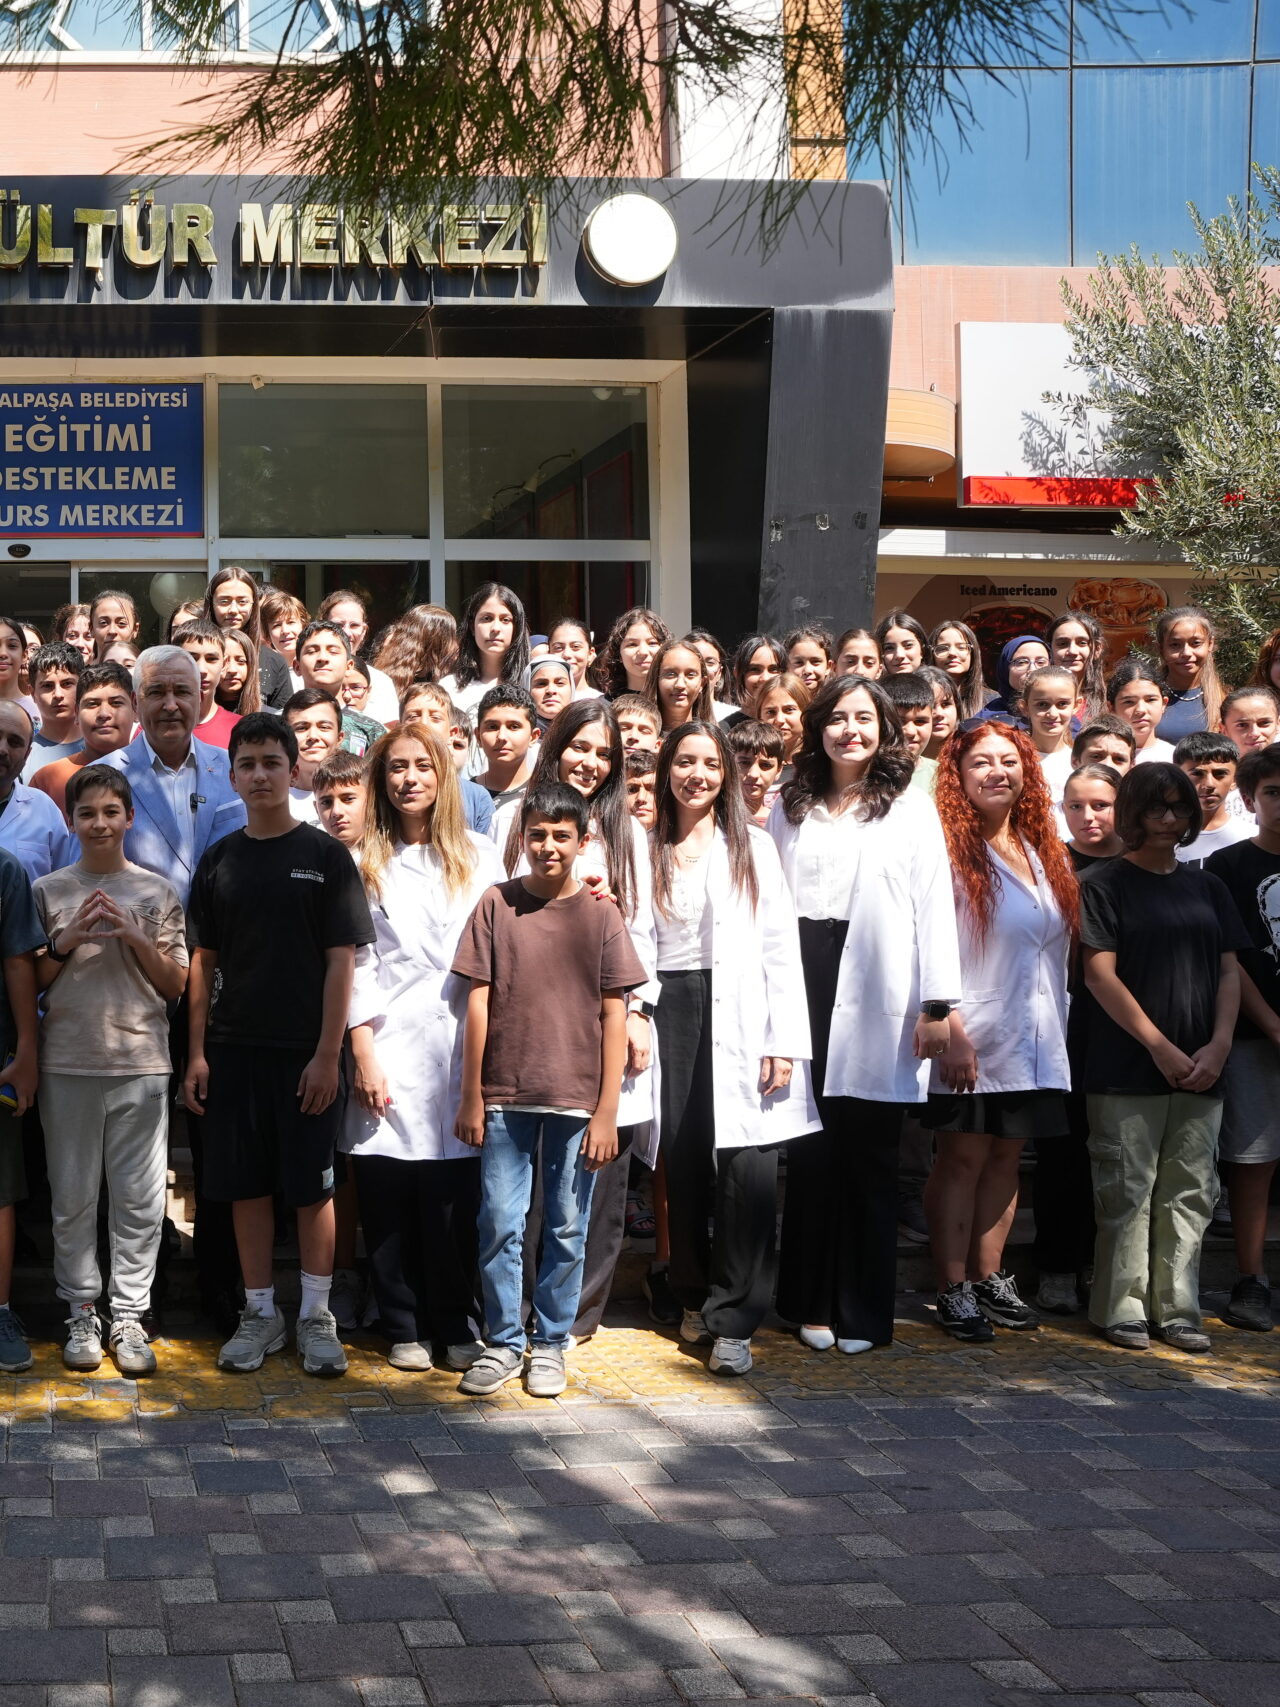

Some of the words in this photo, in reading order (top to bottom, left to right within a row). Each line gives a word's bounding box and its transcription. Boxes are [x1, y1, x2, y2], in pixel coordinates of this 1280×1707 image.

[241, 194, 547, 267] MERKEZİ
[80, 388, 188, 408] BELEDİYESİ
[4, 414, 152, 453] EĞİTİMİ
[59, 497, 185, 526] MERKEZİ
[960, 584, 986, 596] Iced
[988, 584, 1058, 596] Americano
